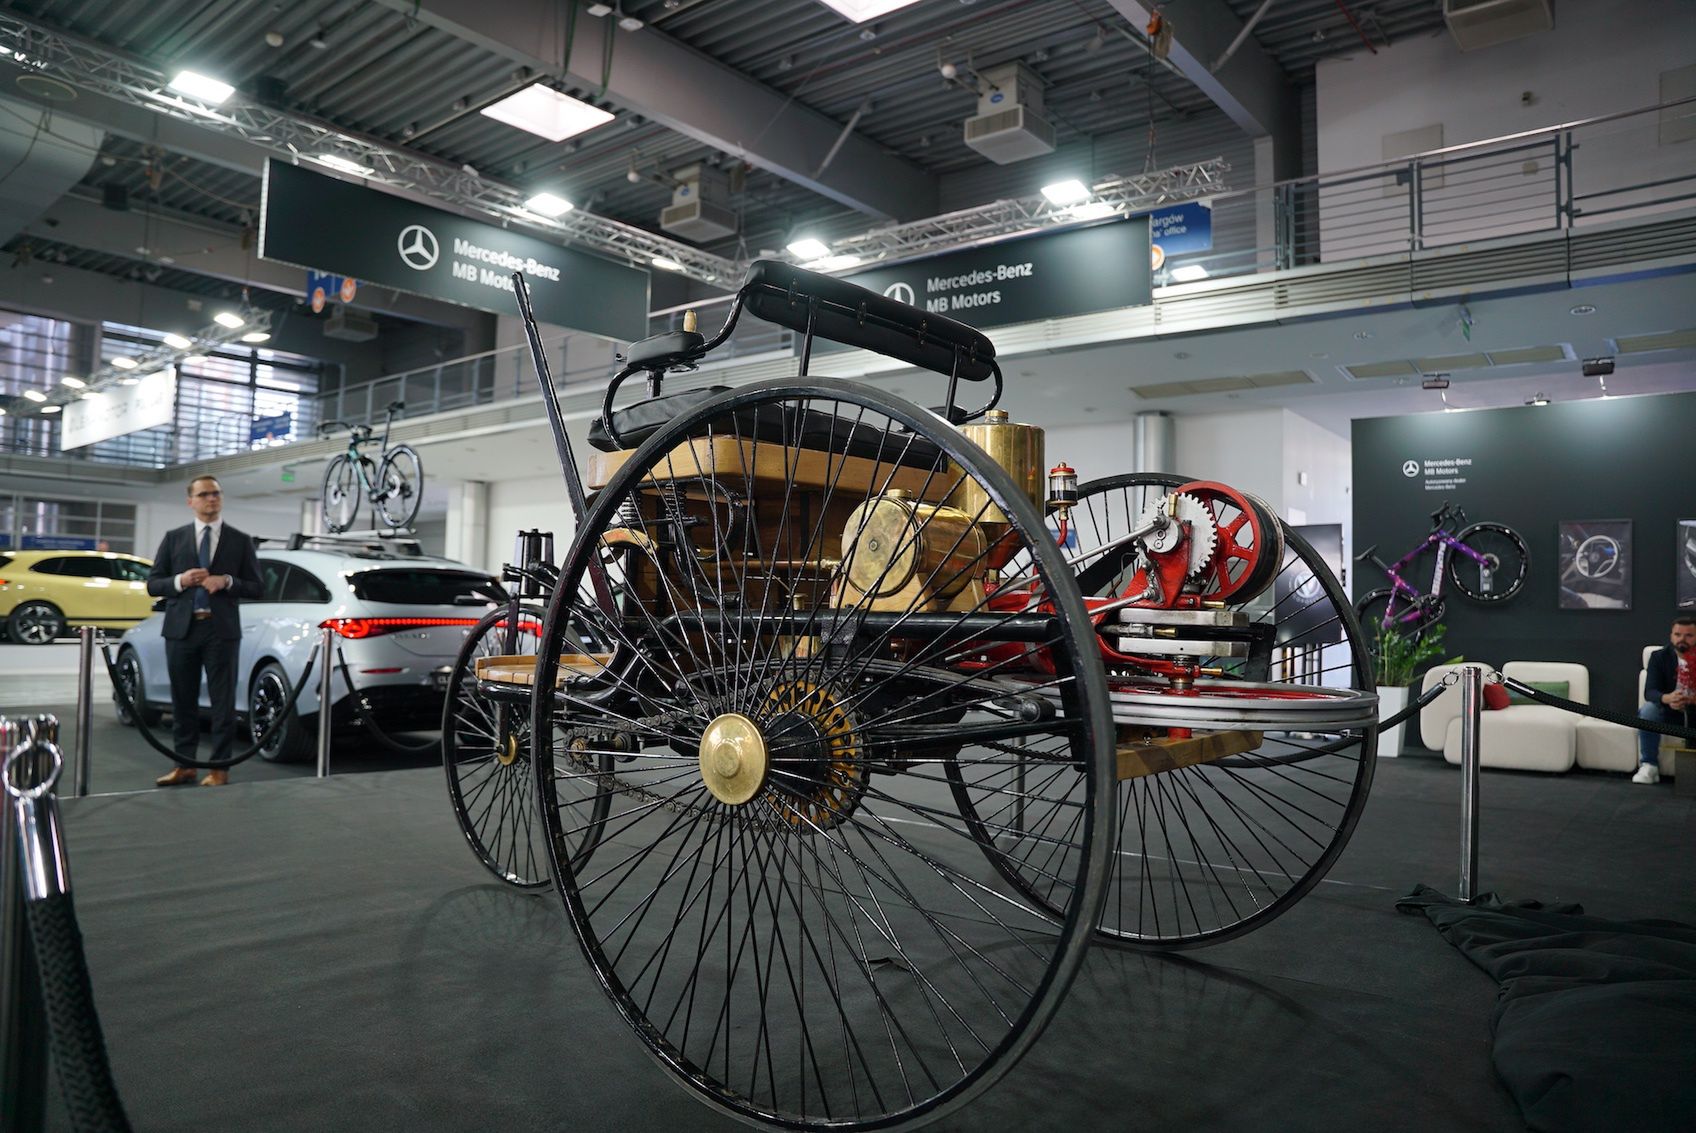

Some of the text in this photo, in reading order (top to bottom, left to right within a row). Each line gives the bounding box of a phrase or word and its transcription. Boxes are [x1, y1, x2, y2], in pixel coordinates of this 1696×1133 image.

[1152, 213, 1184, 228] argów
[454, 238, 560, 281] Mercedes-Benz
[452, 261, 531, 296] MB Motos
[927, 262, 1033, 293] Mercedes-Benz
[926, 289, 1002, 313] MB Motors
[1424, 458, 1472, 467] Mercedes-Benz
[1436, 467, 1459, 475] Motors
